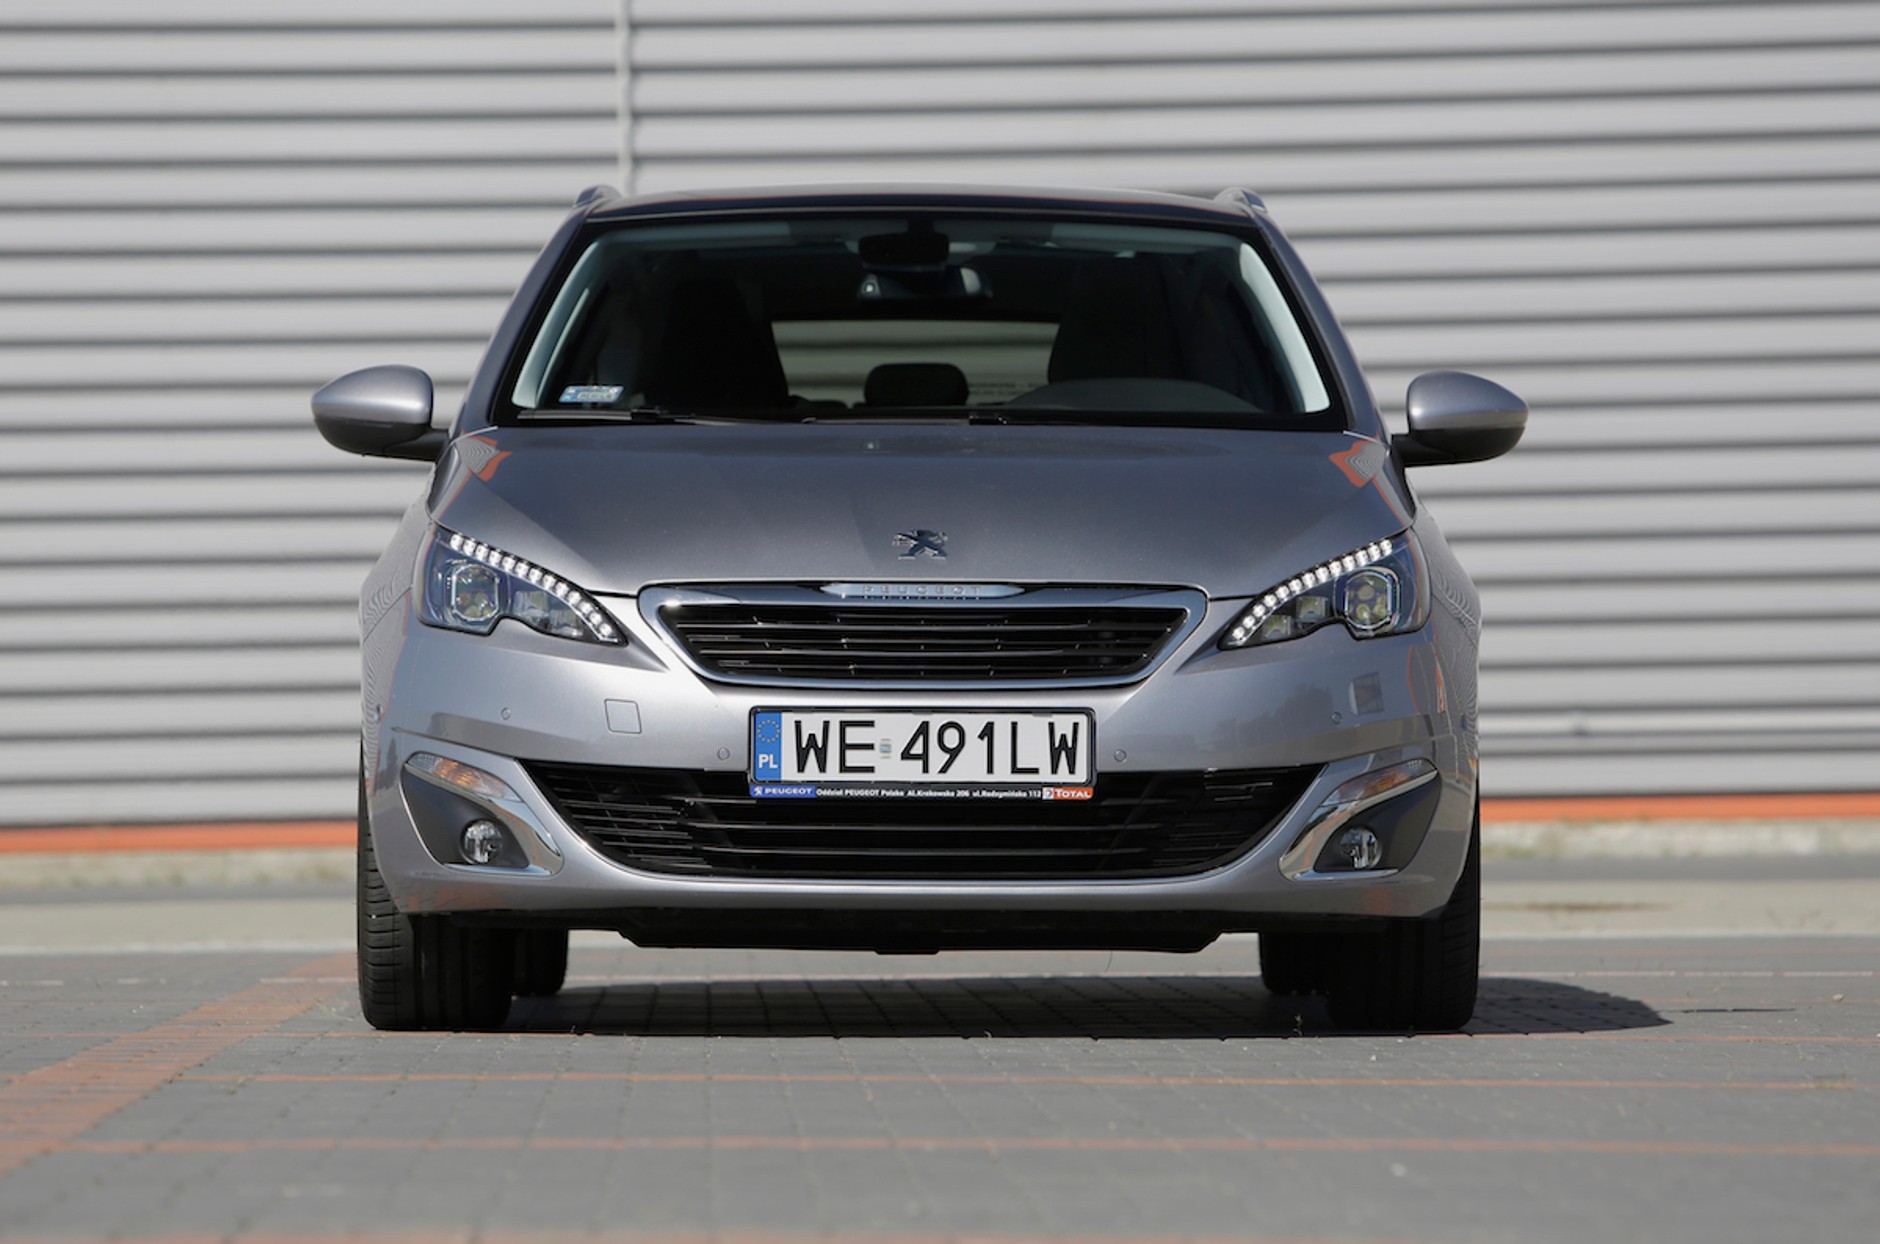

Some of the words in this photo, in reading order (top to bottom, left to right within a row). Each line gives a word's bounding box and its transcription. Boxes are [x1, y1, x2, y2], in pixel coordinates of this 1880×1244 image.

[863, 585, 980, 596] PEUGEOT
[794, 720, 875, 774] WE
[900, 720, 1080, 775] 491LW
[758, 753, 779, 769] PL
[765, 786, 813, 795] PEUGEOT
[844, 789, 879, 797] PEUGEOT
[1055, 787, 1092, 799] TOTAL
